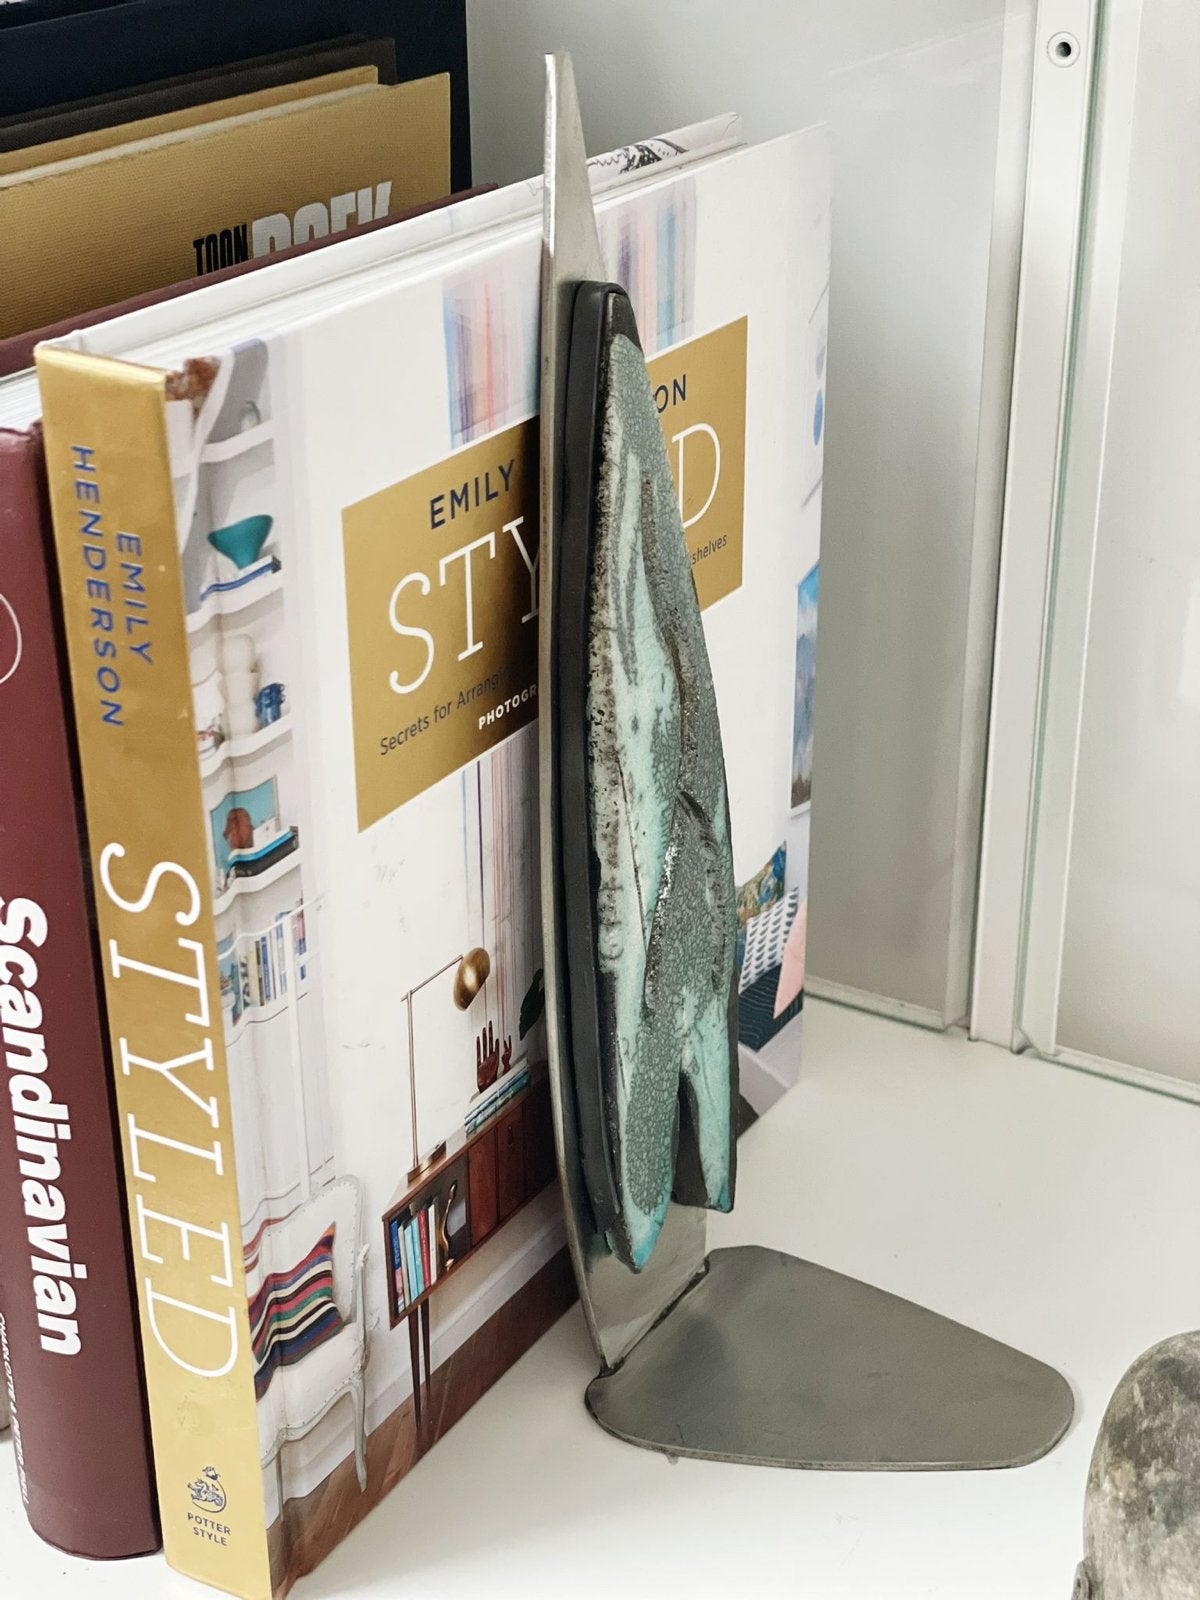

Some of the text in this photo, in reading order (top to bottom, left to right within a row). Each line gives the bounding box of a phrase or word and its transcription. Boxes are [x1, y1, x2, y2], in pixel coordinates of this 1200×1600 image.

[430, 458, 516, 530] EMILY
[71, 445, 124, 726] HENDERSON
[116, 532, 153, 664] EMILY
[379, 671, 500, 756] Secrets for Arrang
[478, 683, 540, 731] PHOTOGR
[0, 897, 88, 1356] Scandinavian
[100, 842, 238, 1378] STYLED
[187, 1512, 231, 1536] POTTER
[193, 1526, 228, 1547] STYLE
